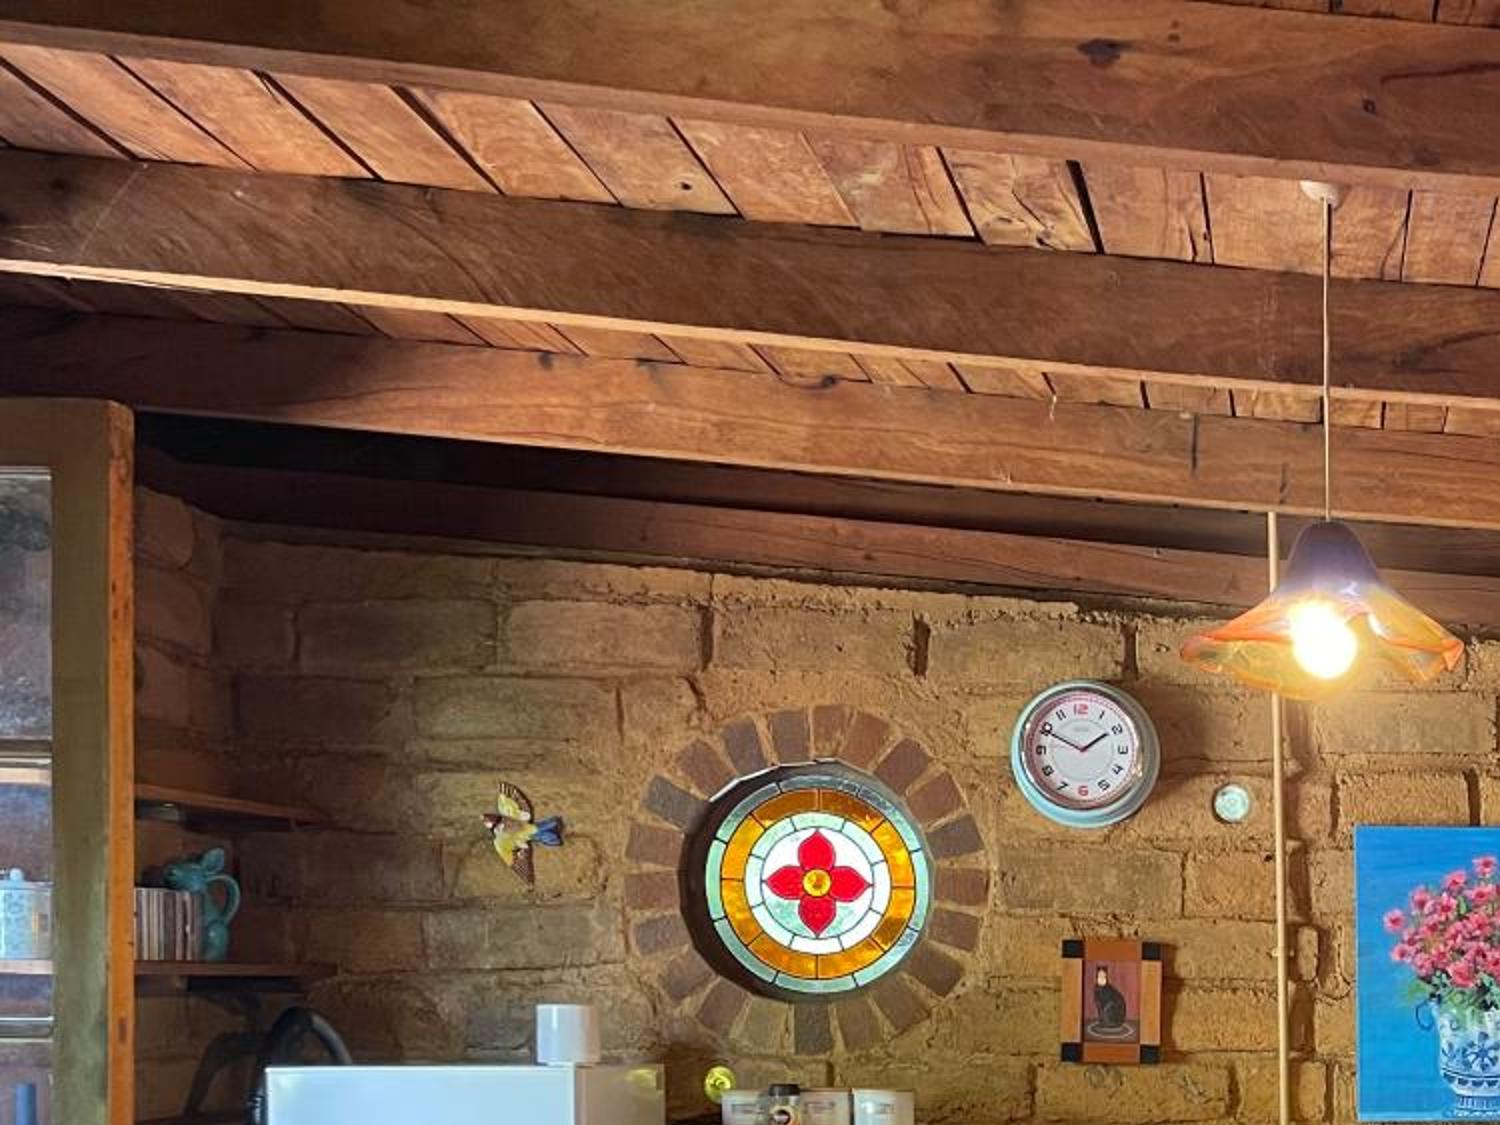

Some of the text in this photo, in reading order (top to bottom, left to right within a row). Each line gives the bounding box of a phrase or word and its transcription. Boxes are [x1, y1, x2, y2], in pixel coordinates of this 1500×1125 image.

[1073, 703, 1089, 715] 12
[1099, 710, 1105, 719] 1
[1111, 723, 1123, 734] 2
[1118, 745, 1128, 755] 3
[1041, 765, 1054, 776] 8
[1112, 764, 1124, 775] 4
[1057, 781, 1069, 790] 7
[1097, 779, 1110, 790] 5
[1078, 785, 1089, 796] 6
